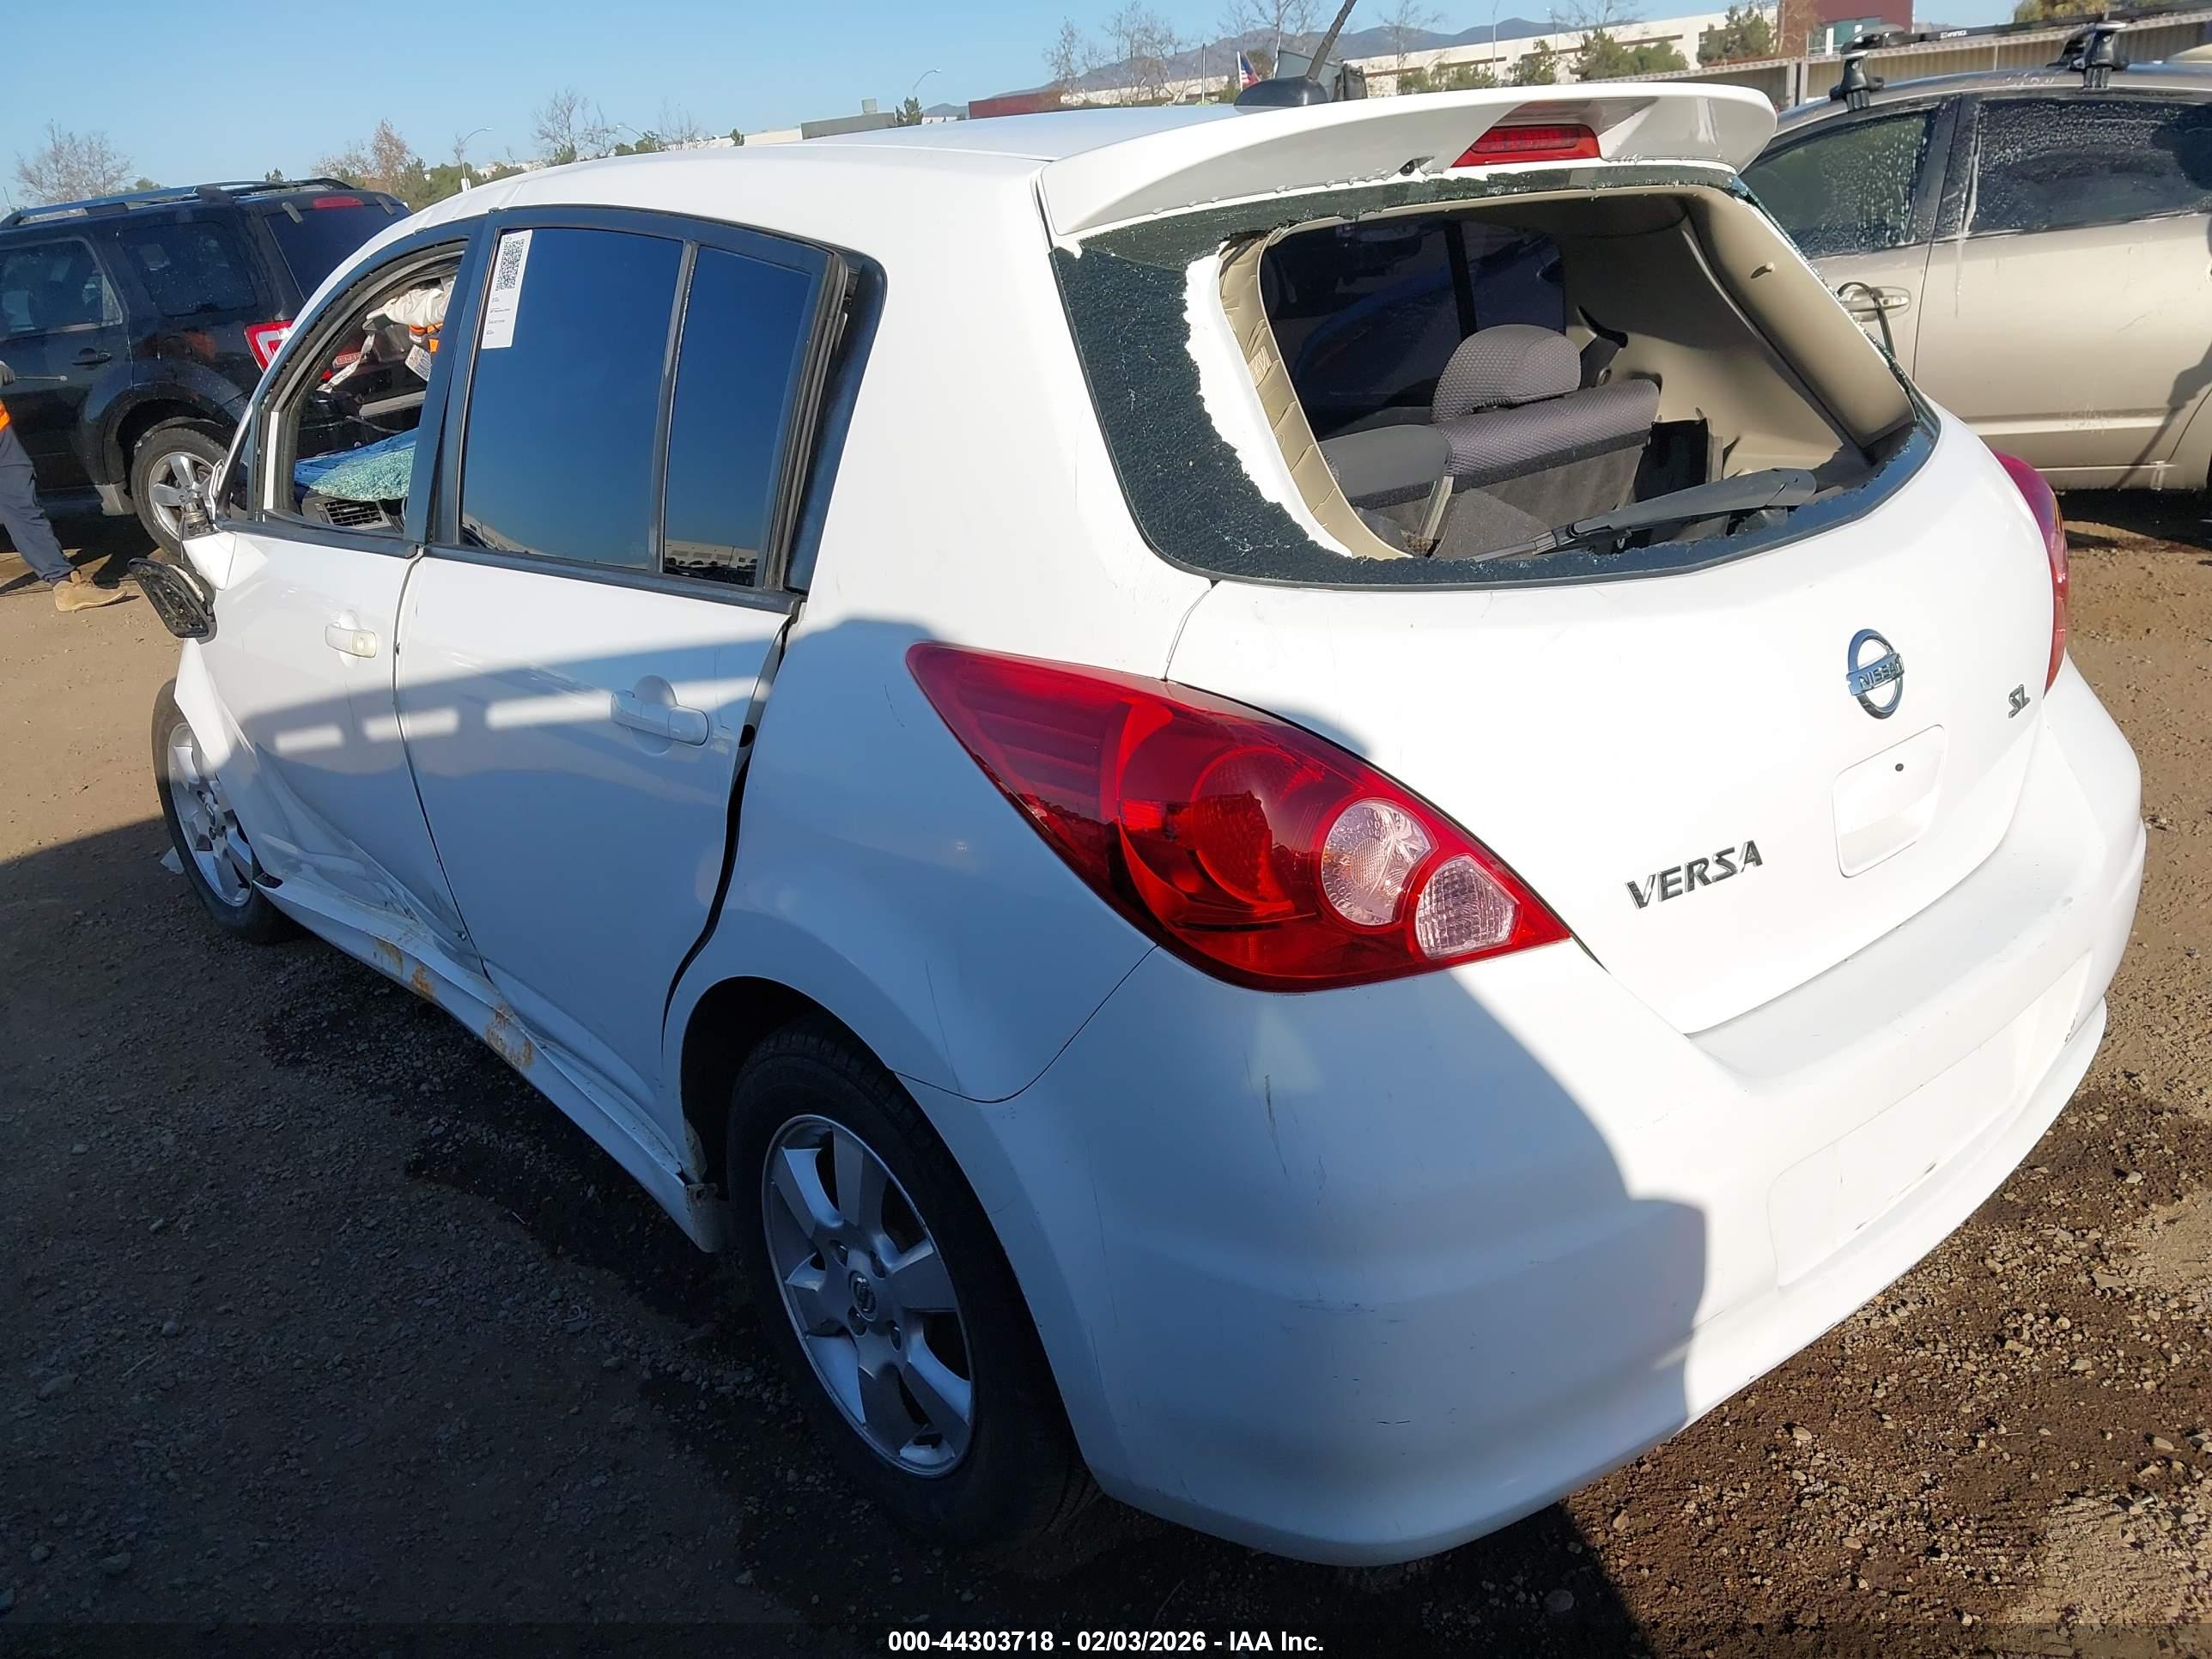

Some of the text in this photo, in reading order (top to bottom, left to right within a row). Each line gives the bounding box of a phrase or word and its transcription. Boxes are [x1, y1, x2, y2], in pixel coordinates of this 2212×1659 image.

[1857, 657, 1905, 690] NISSAN
[2008, 684, 2031, 719] SL
[1625, 839, 1764, 909] VERSA
